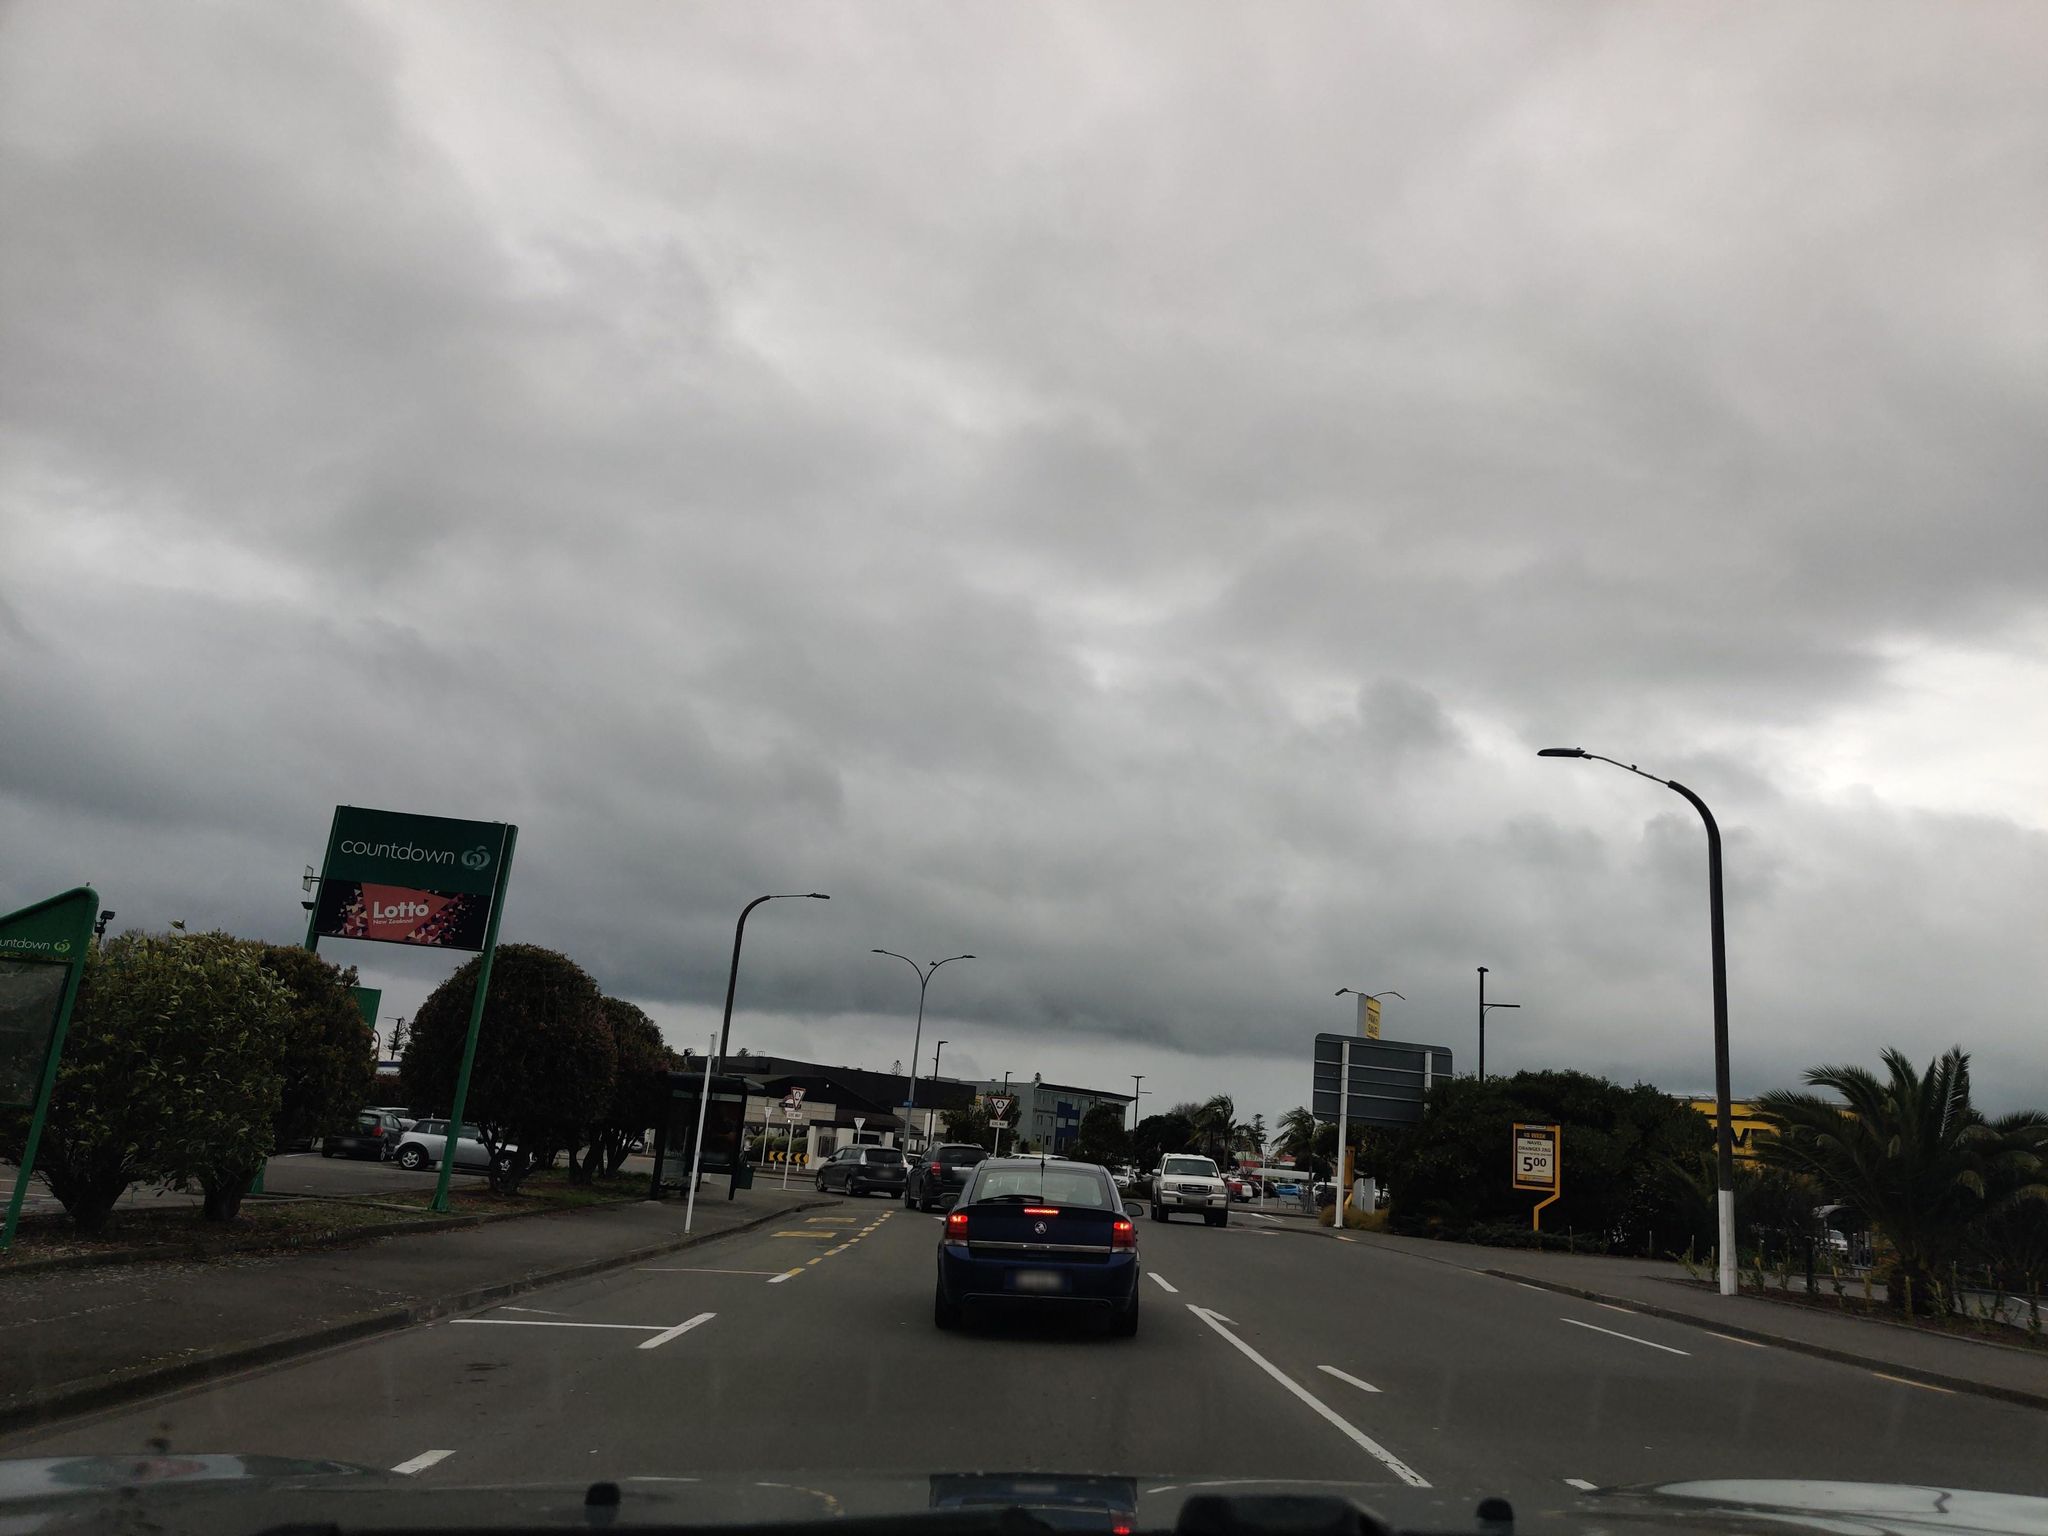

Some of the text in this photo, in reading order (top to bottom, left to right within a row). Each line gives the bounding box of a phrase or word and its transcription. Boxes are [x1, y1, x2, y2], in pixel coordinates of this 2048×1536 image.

[340, 840, 455, 865] countdown
[373, 901, 429, 919] Lotto
[0, 937, 51, 950] untdown
